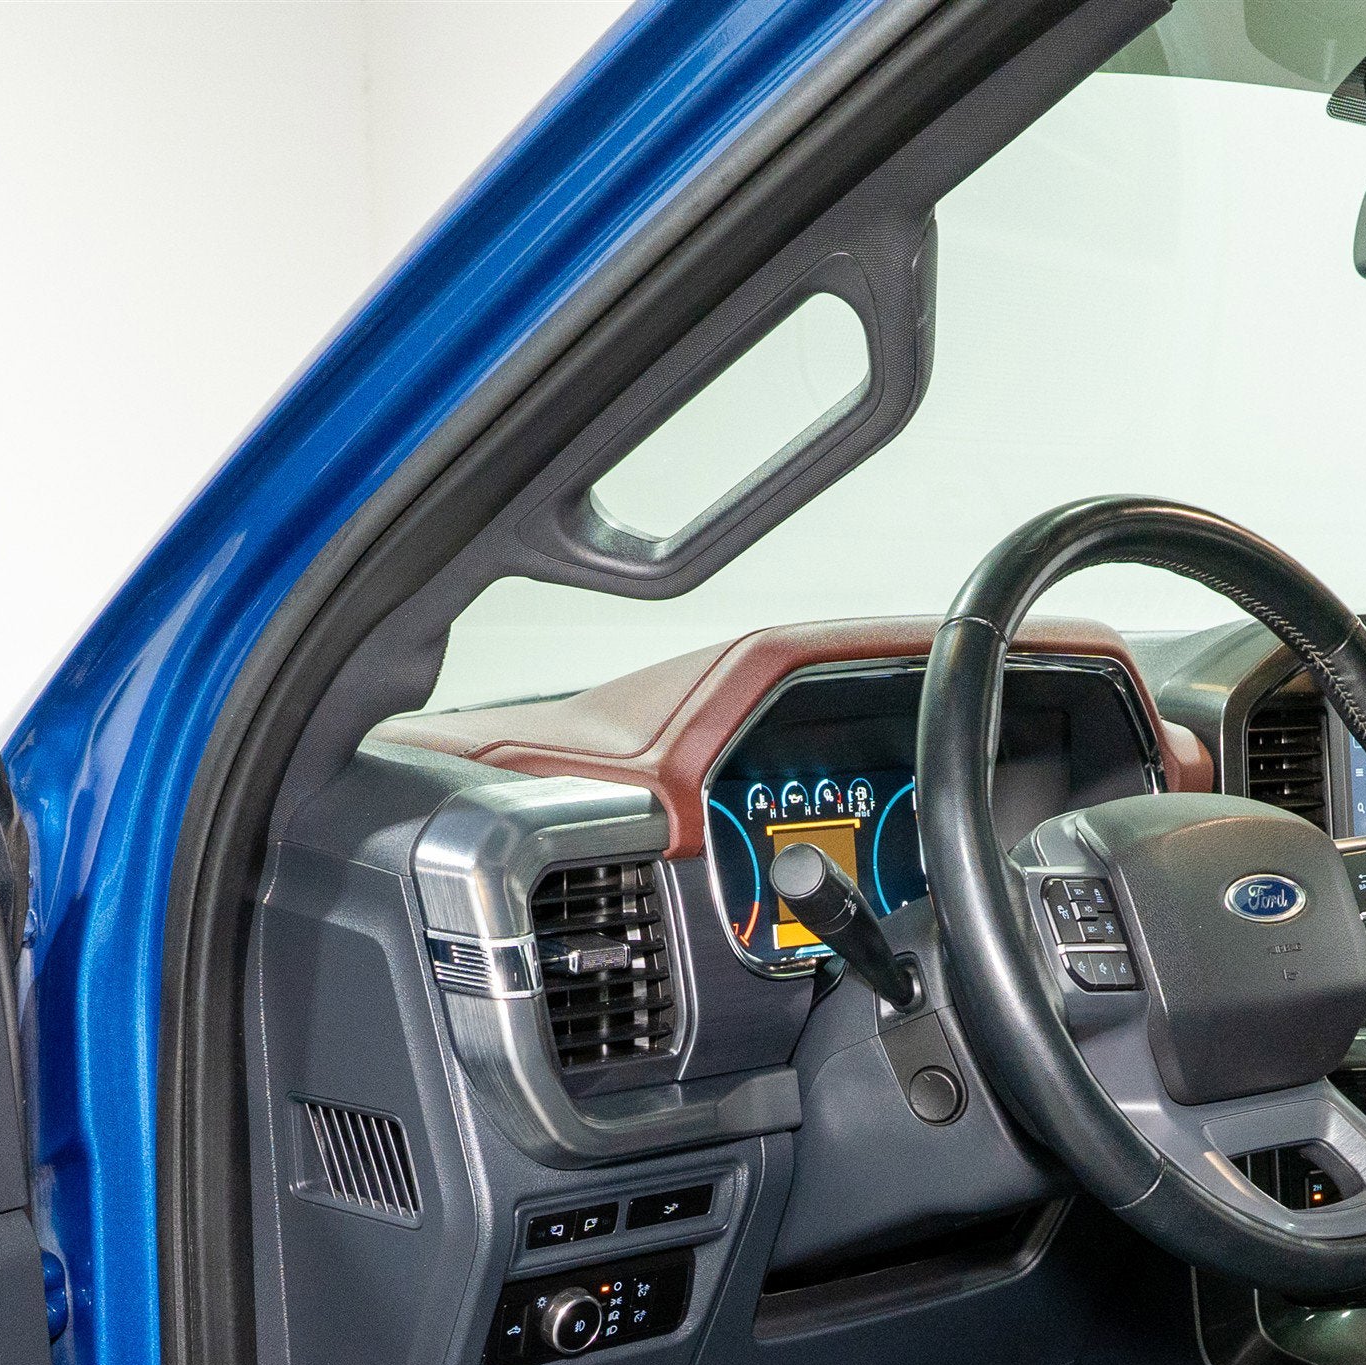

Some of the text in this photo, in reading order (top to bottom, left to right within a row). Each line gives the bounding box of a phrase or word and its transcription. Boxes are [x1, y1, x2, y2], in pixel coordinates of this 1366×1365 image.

[815, 805, 820, 815] C
[837, 802, 843, 813] H
[848, 802, 854, 812] E
[870, 800, 876, 810] F
[747, 810, 753, 820] C
[770, 808, 776, 818] H
[782, 808, 787, 818] L
[805, 805, 811, 816] H
[1247, 884, 1289, 911] Ford
